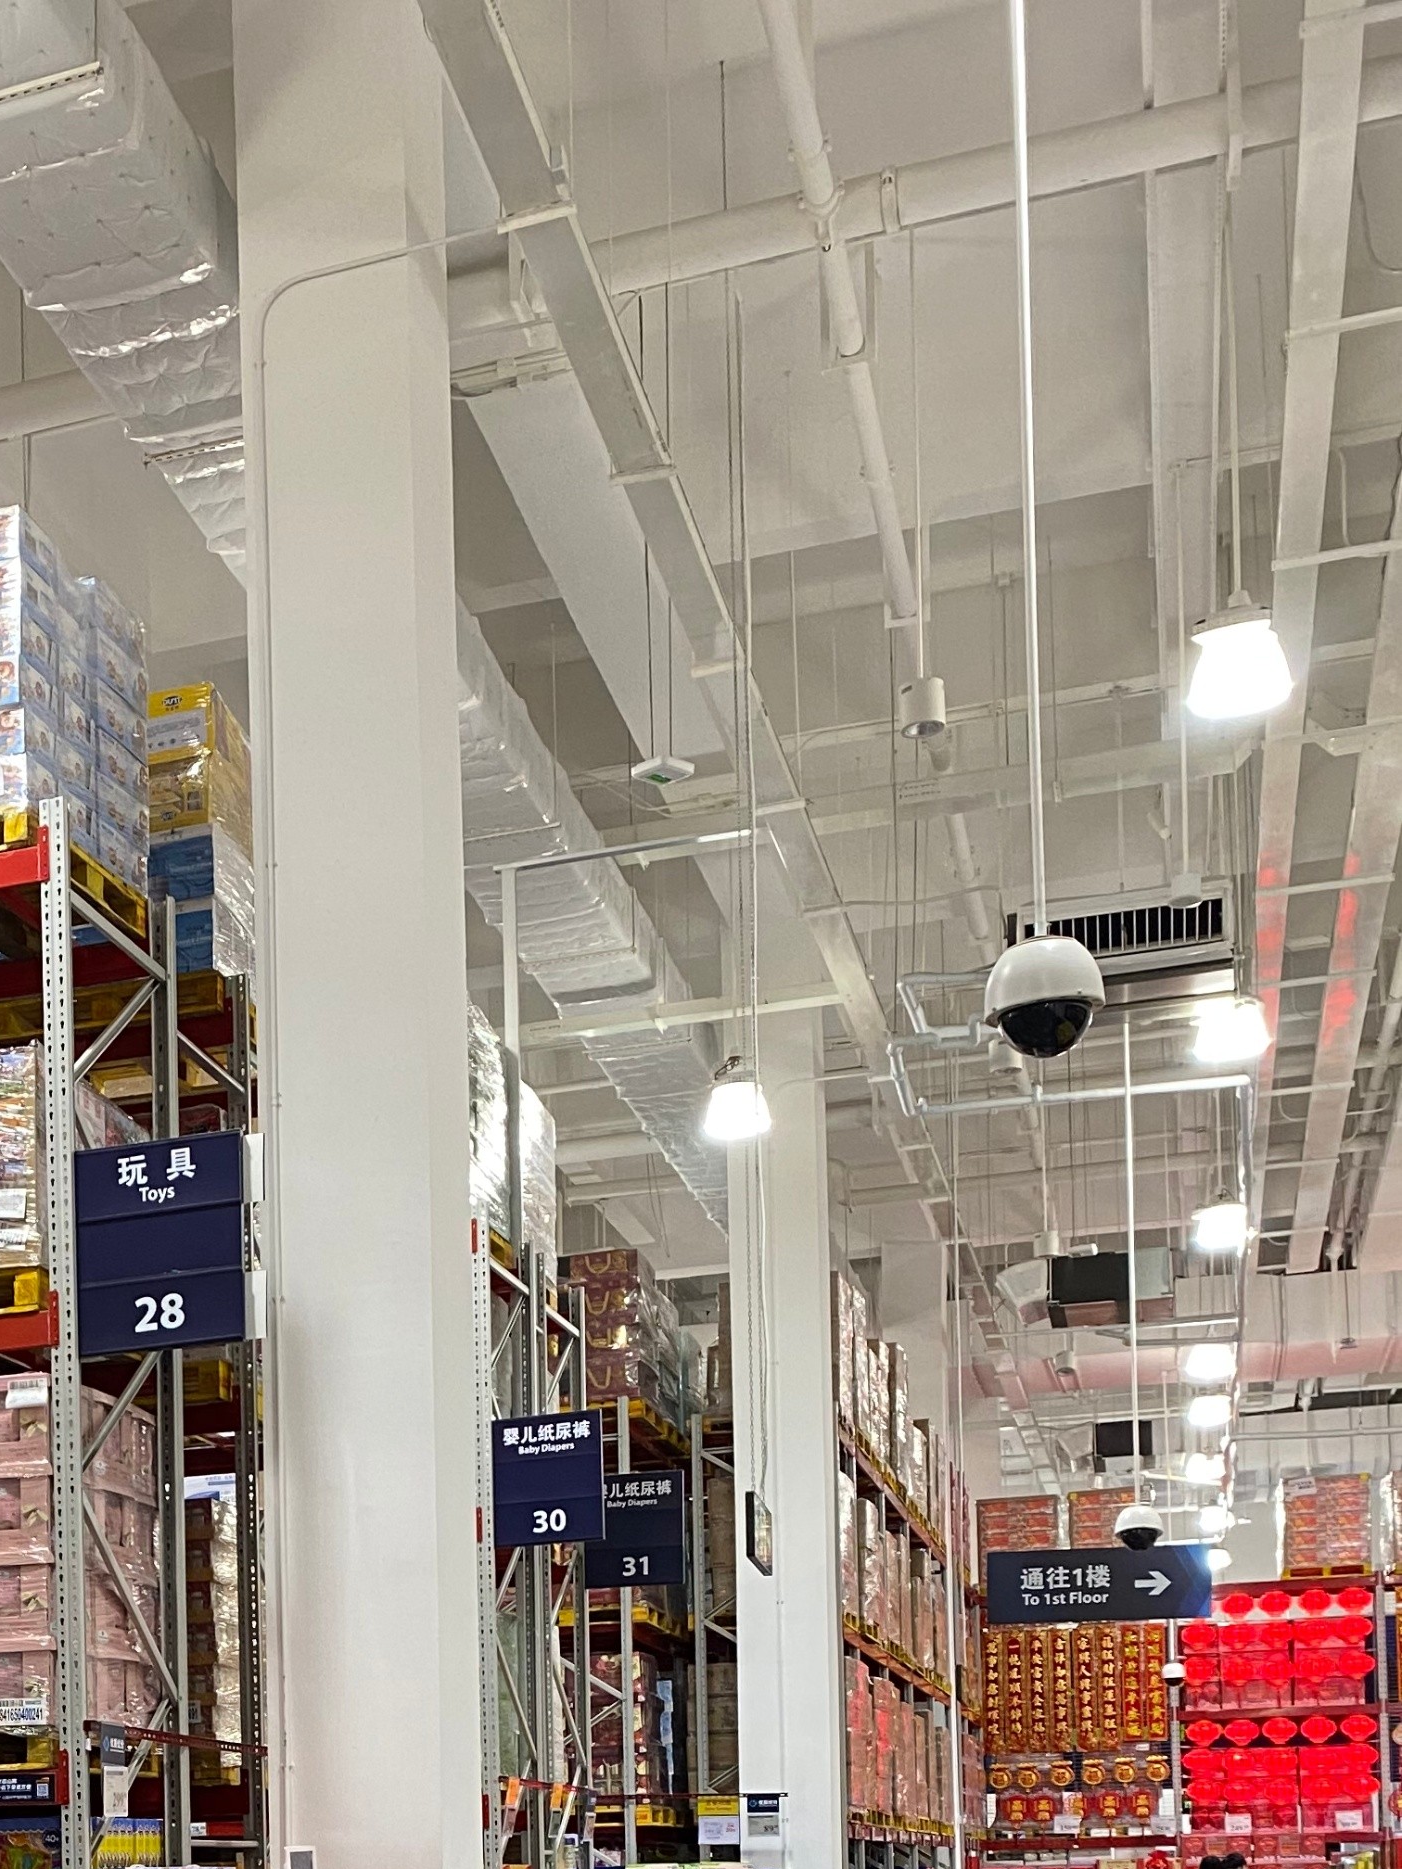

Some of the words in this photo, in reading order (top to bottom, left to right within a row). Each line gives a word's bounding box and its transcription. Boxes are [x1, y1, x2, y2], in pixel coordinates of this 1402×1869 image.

[117, 1147, 196, 1187] 玩具
[138, 1186, 175, 1203] Toys
[134, 1292, 185, 1333] 28
[503, 1420, 591, 1446] 婴儿纸尿裤
[518, 1444, 540, 1455] Baby
[541, 1441, 574, 1453] Diapers
[607, 1500, 626, 1509] Baby
[628, 1497, 657, 1507] Diapers
[532, 1508, 566, 1533] 30
[622, 1556, 649, 1577] 31
[1020, 1565, 1111, 1590] 通往1楼
[1022, 1594, 1040, 1605] To
[1044, 1594, 1066, 1605] 1st
[1069, 1591, 1109, 1604] Floor
